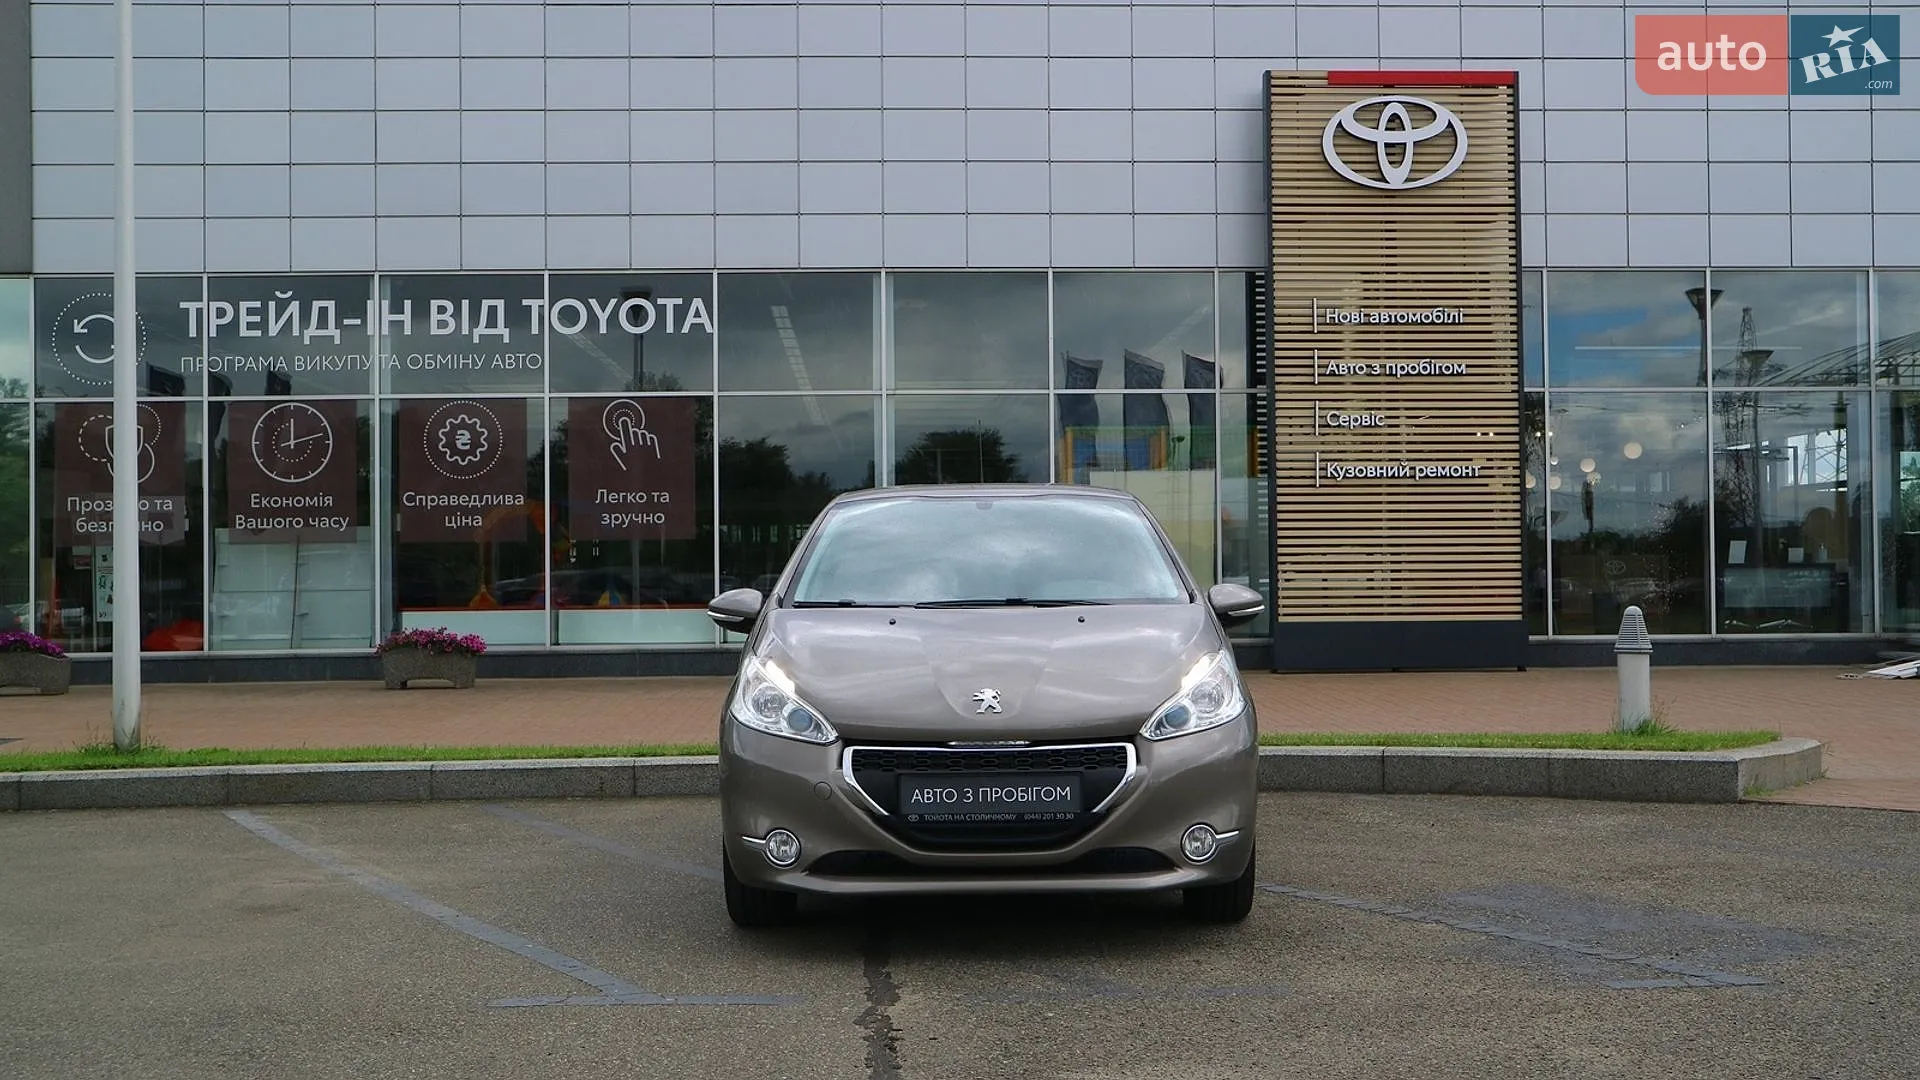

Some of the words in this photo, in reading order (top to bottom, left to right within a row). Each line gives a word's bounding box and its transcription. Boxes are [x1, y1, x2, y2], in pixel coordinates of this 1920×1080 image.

[179, 290, 412, 345] ТРЕЙД-ІН
[430, 298, 510, 343] ВІД
[521, 297, 714, 336] TOYOTA
[1325, 308, 1365, 324] Нові
[1369, 307, 1464, 324] автомобілі
[181, 356, 287, 373] ПРОГРАМА
[294, 354, 373, 371] ВИКУПУ
[378, 354, 401, 370] ТА
[406, 352, 486, 370] ОБМІНУ
[490, 352, 543, 370] АВТО
[1326, 359, 1367, 375] Авто
[1370, 363, 1381, 375] з
[1385, 358, 1467, 378] пробігом
[1326, 410, 1385, 430] Сервіс
[1326, 460, 1411, 481] Кузовний
[1415, 464, 1481, 480] ремонт
[67, 496, 149, 514] Прозо
[154, 499, 173, 511] та
[250, 492, 333, 508] Економія
[402, 491, 525, 509] Справедлива
[595, 489, 647, 504] Легко
[650, 491, 671, 504] та
[235, 514, 304, 529] Вашого
[308, 516, 349, 533] часу
[445, 511, 482, 528] ціна
[600, 510, 665, 528] зручно
[910, 788, 958, 804] АВТО
[962, 787, 974, 802] З
[978, 786, 1072, 802] ПРОБІГОМ
